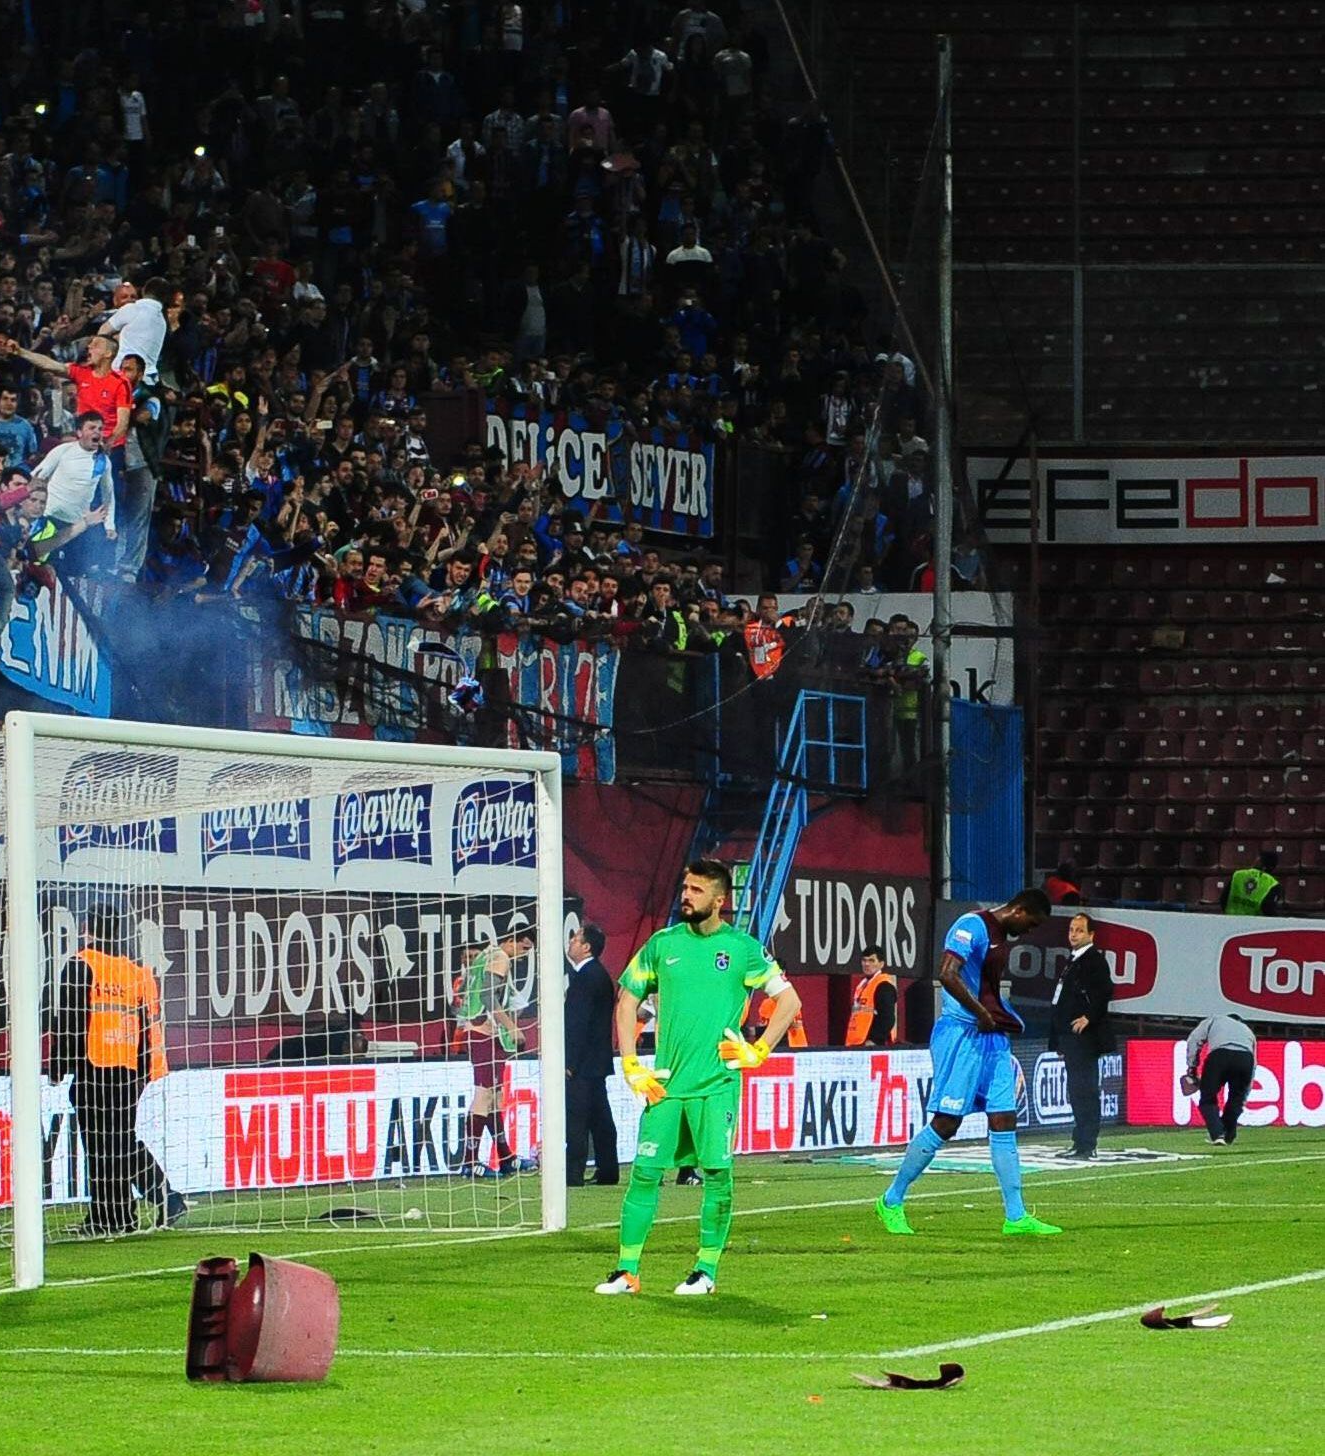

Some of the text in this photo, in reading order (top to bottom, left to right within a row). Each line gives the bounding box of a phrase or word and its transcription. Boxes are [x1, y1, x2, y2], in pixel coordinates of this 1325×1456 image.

[629, 441, 708, 519] SEVER
[179, 907, 375, 1018] TUDORS
[794, 878, 917, 970] TUDORS
[224, 1068, 376, 1188] MUTLU
[383, 1094, 467, 1176] AKÜ
[799, 1080, 858, 1148] AKÜ
